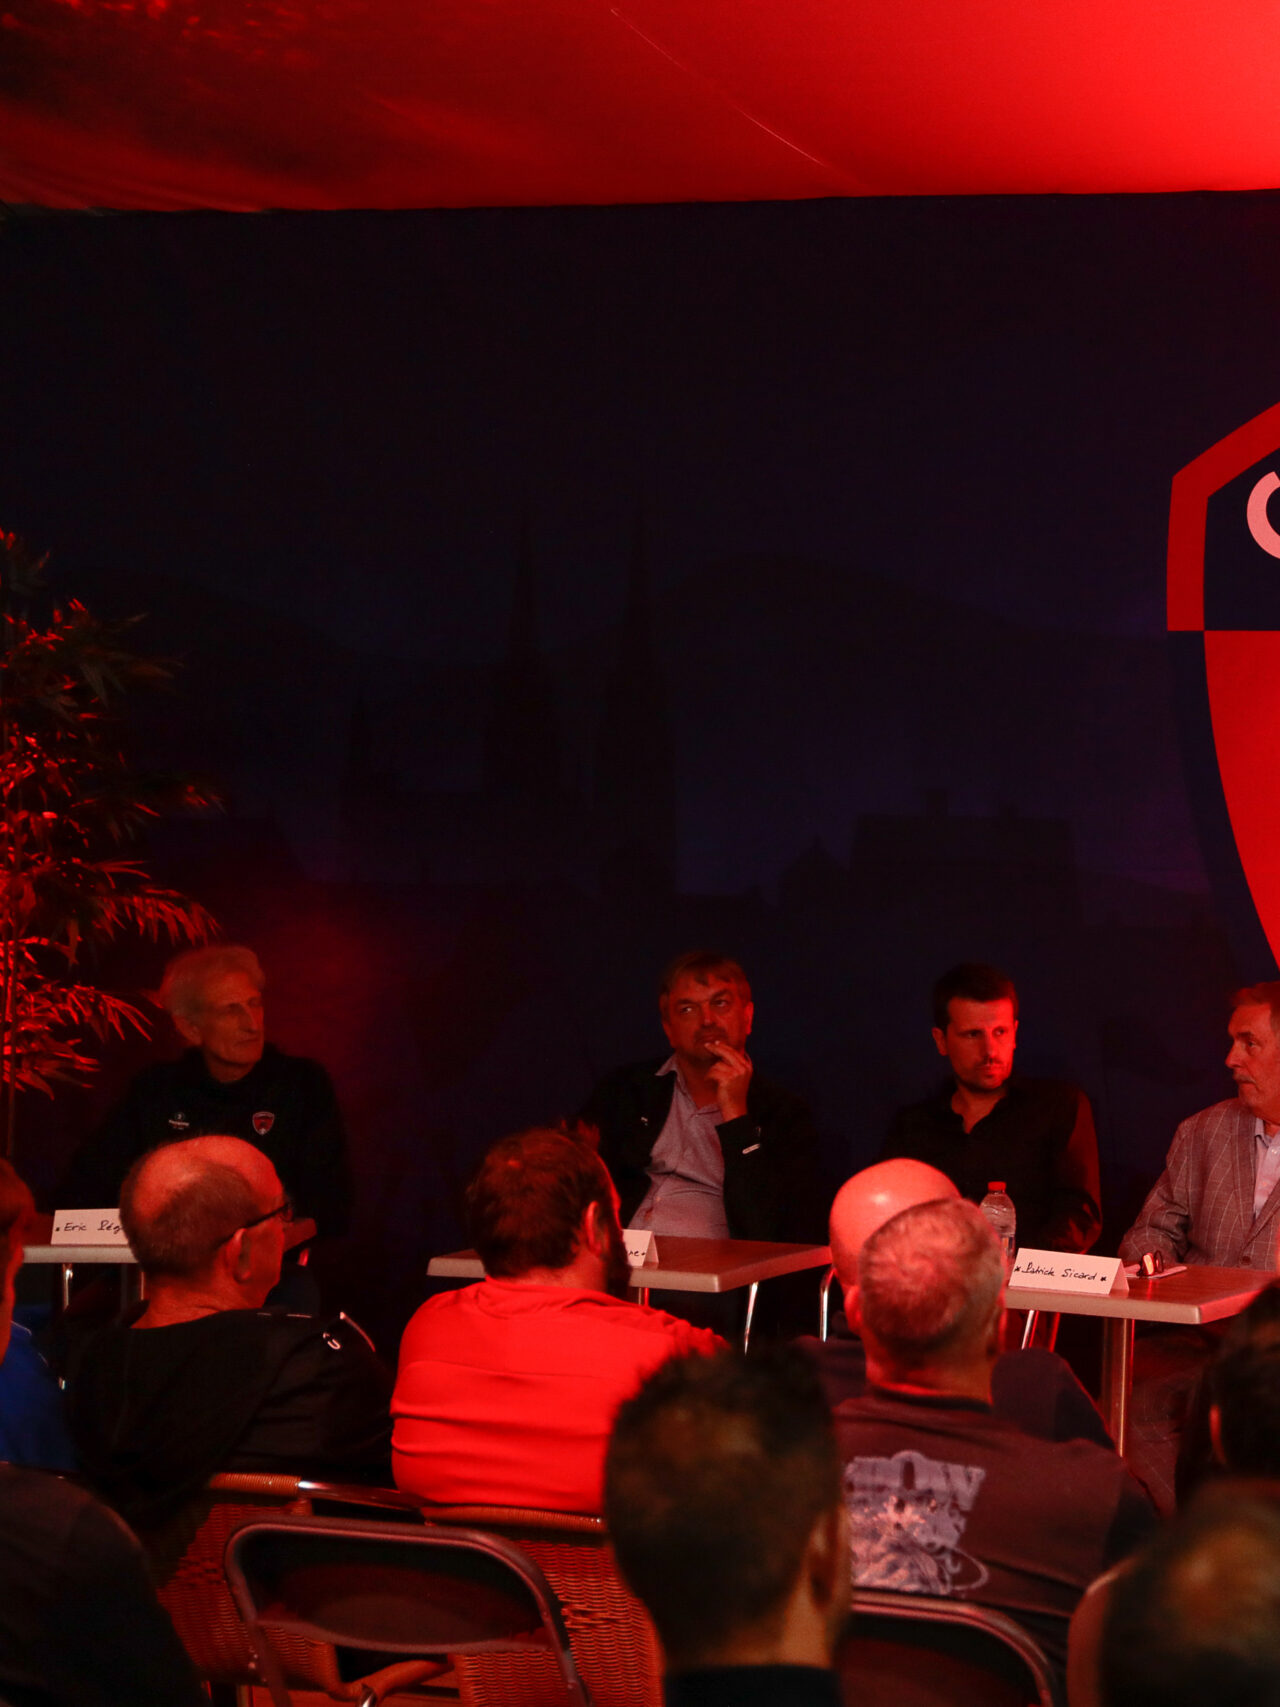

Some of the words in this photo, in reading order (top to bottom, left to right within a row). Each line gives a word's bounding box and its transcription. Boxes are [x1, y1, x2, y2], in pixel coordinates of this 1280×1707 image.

[64, 1222, 87, 1232] Eric
[1021, 1261, 1055, 1277] Patrick
[1061, 1268, 1098, 1281] Sicard
